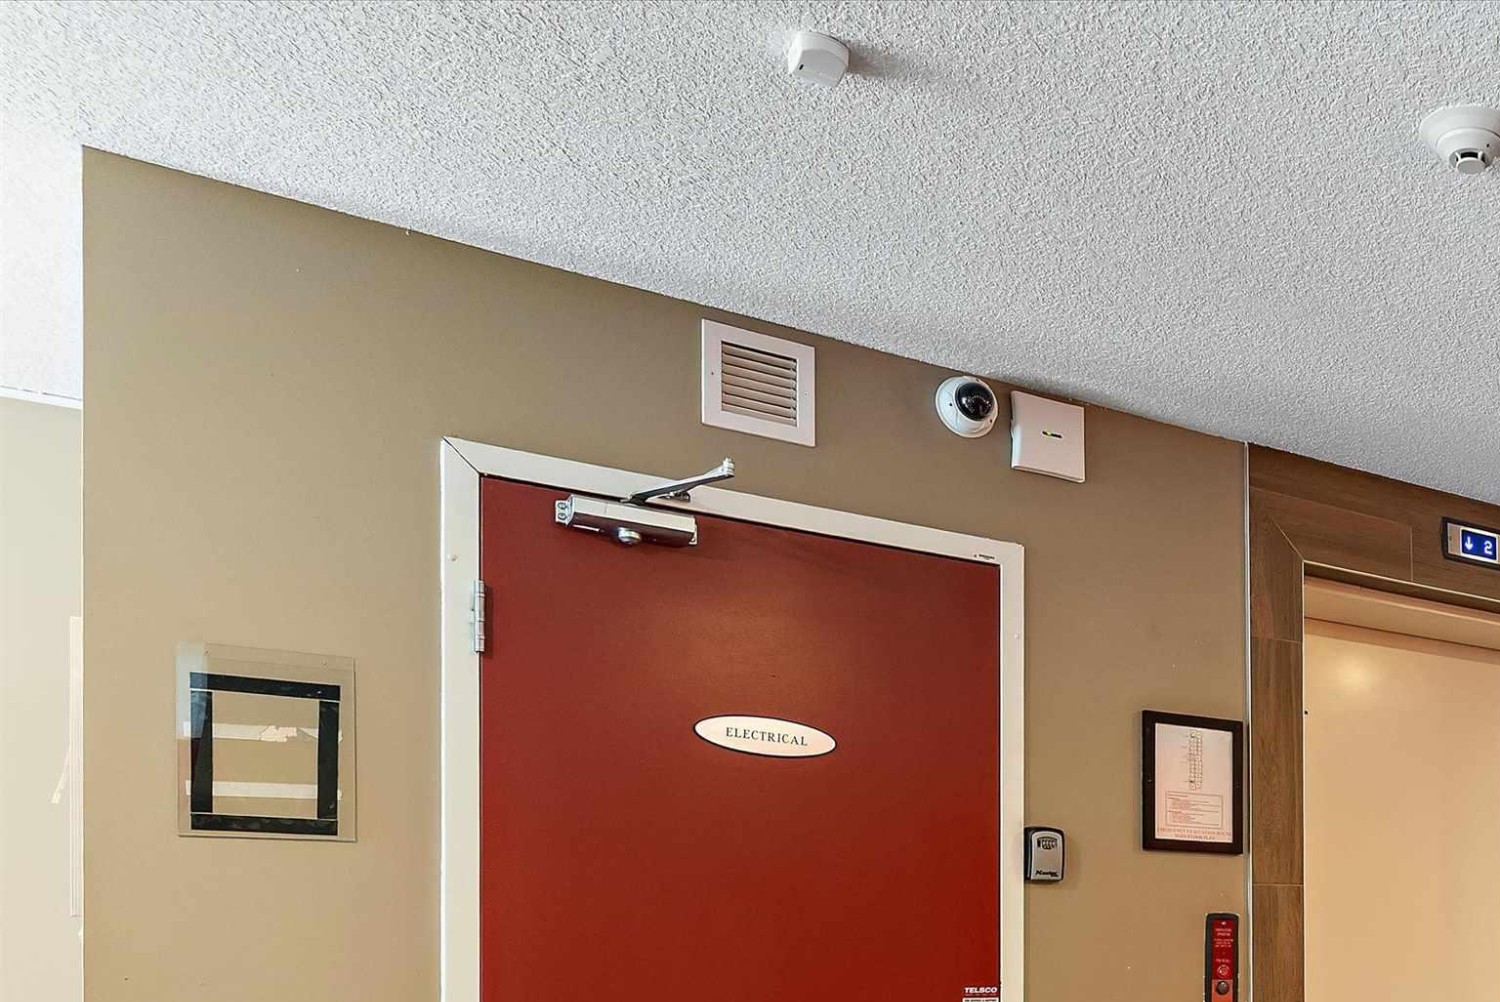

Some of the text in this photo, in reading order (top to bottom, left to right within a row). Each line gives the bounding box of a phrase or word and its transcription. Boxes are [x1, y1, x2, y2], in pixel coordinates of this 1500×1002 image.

[1483, 540, 1493, 555] 2
[725, 726, 808, 746] ELECTRICAL
[964, 986, 998, 994] TELSCO
